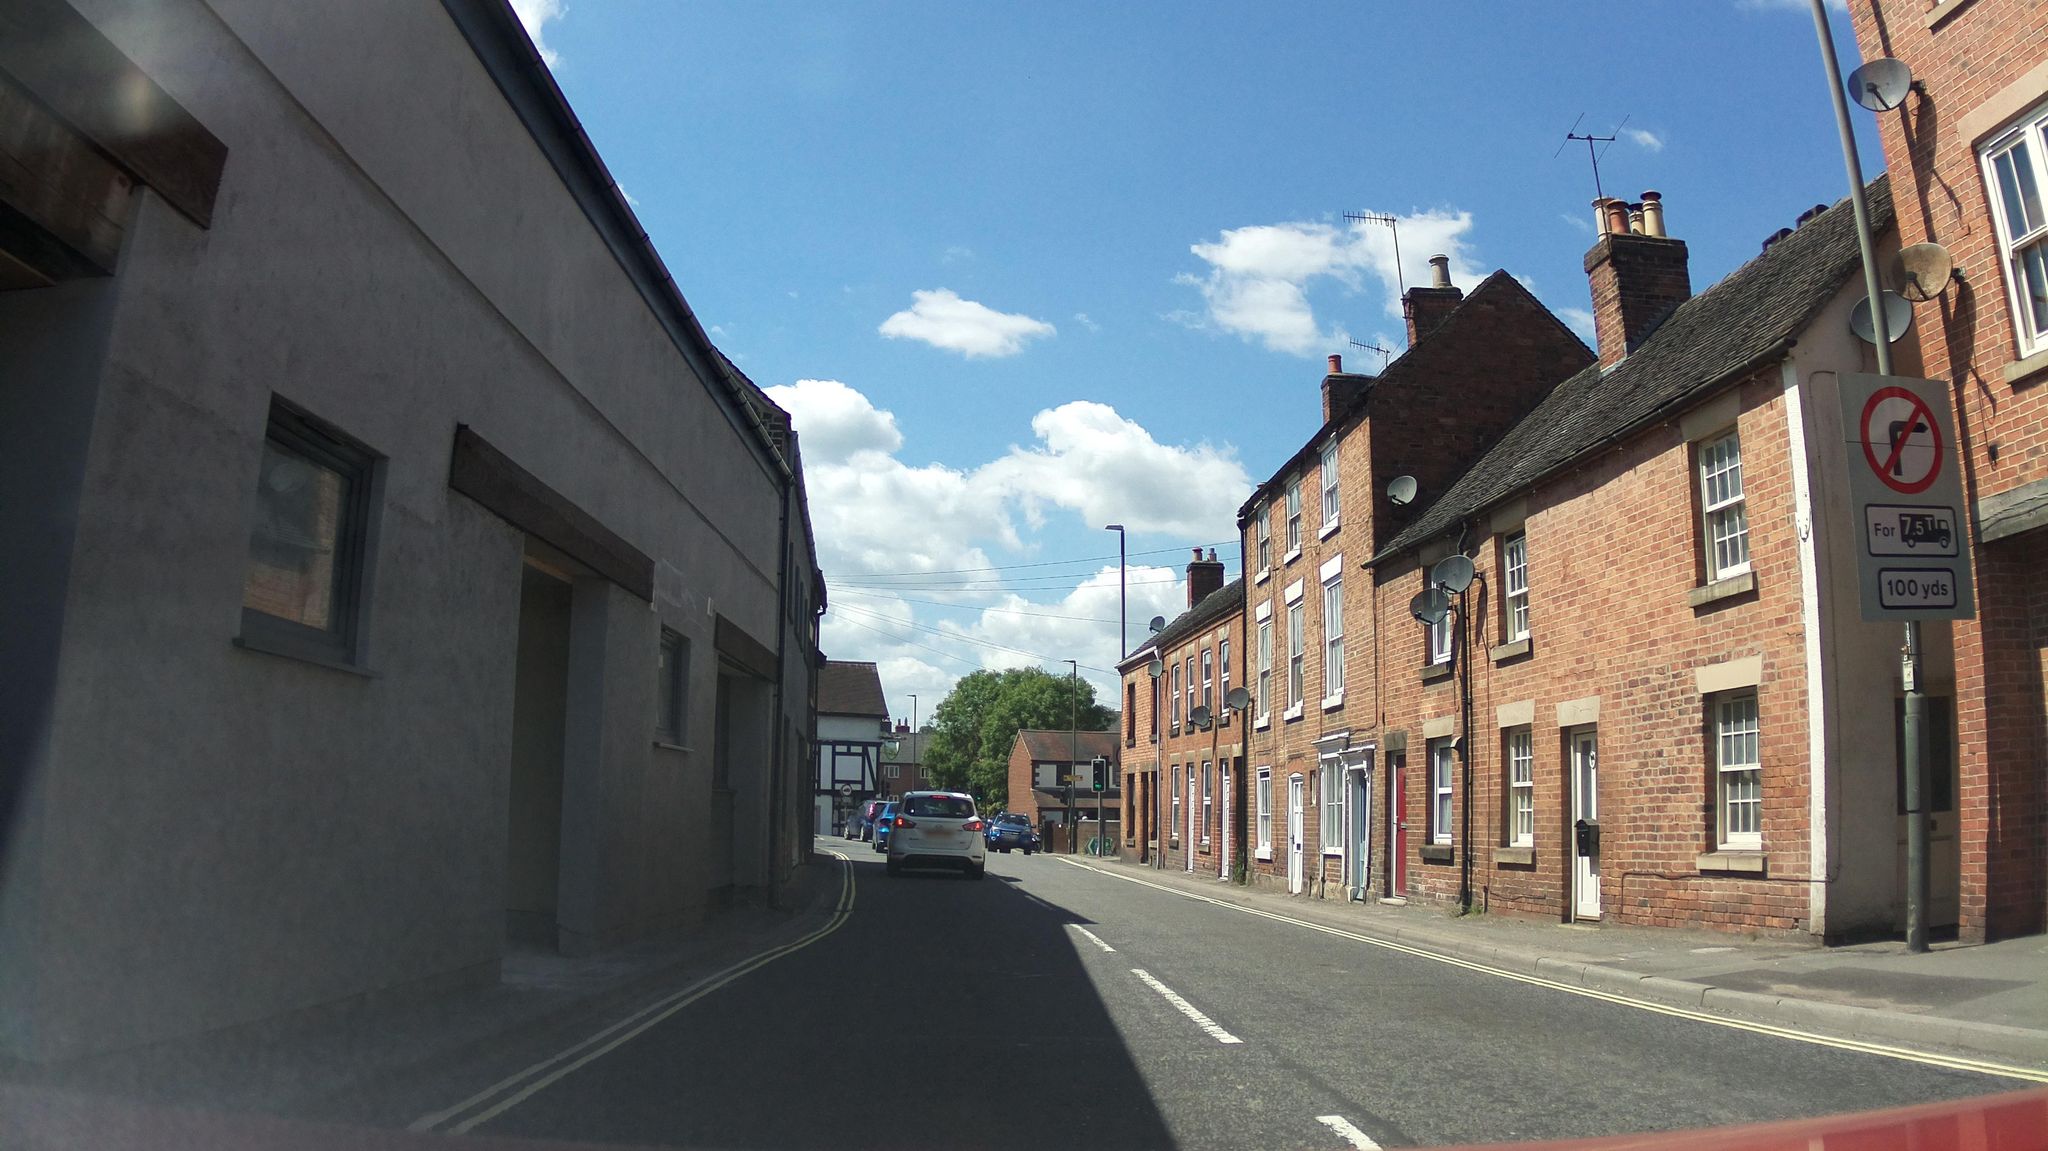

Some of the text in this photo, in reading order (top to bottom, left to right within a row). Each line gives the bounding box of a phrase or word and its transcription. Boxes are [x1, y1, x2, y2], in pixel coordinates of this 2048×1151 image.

[1874, 523, 1896, 537] For
[1887, 579, 1949, 599] 100 yds
